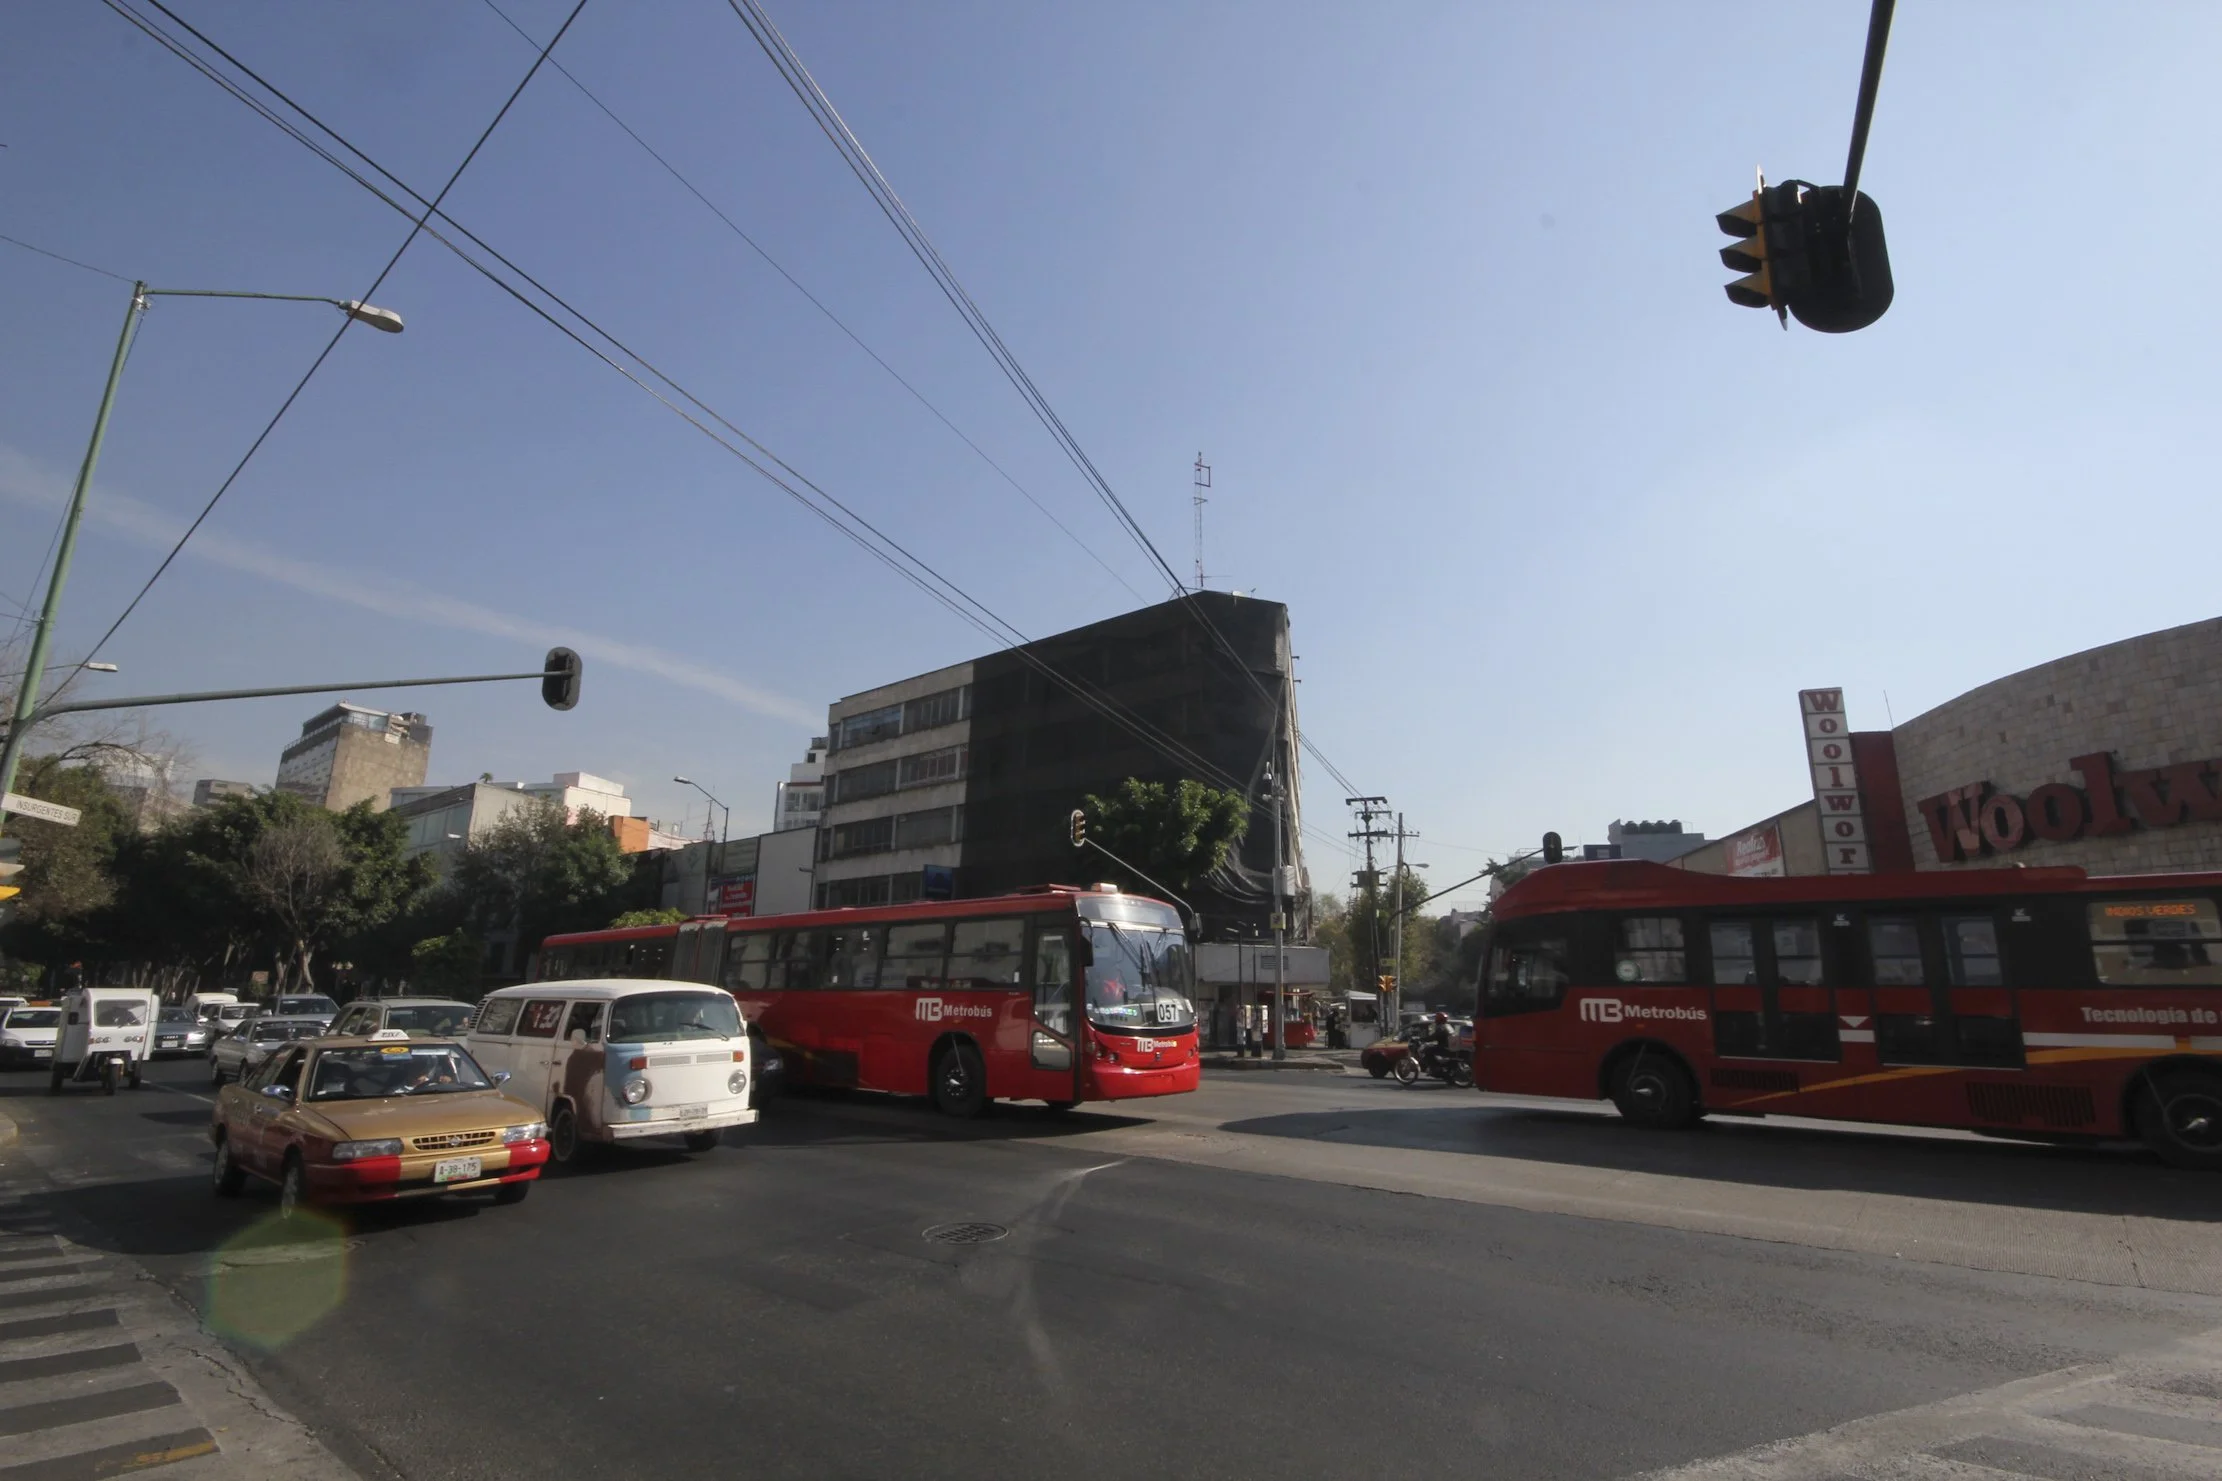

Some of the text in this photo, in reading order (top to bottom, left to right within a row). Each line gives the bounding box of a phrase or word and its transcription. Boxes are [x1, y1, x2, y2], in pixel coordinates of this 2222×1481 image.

[1805, 690, 1858, 874] Woolwor
[16, 800, 78, 821] INSURGENTES SUR
[943, 1004, 992, 1018] Metrobús
[1159, 1003, 1177, 1020] 057
[1624, 1004, 1707, 1020] Metrobús
[2191, 1008, 2218, 1024] de
